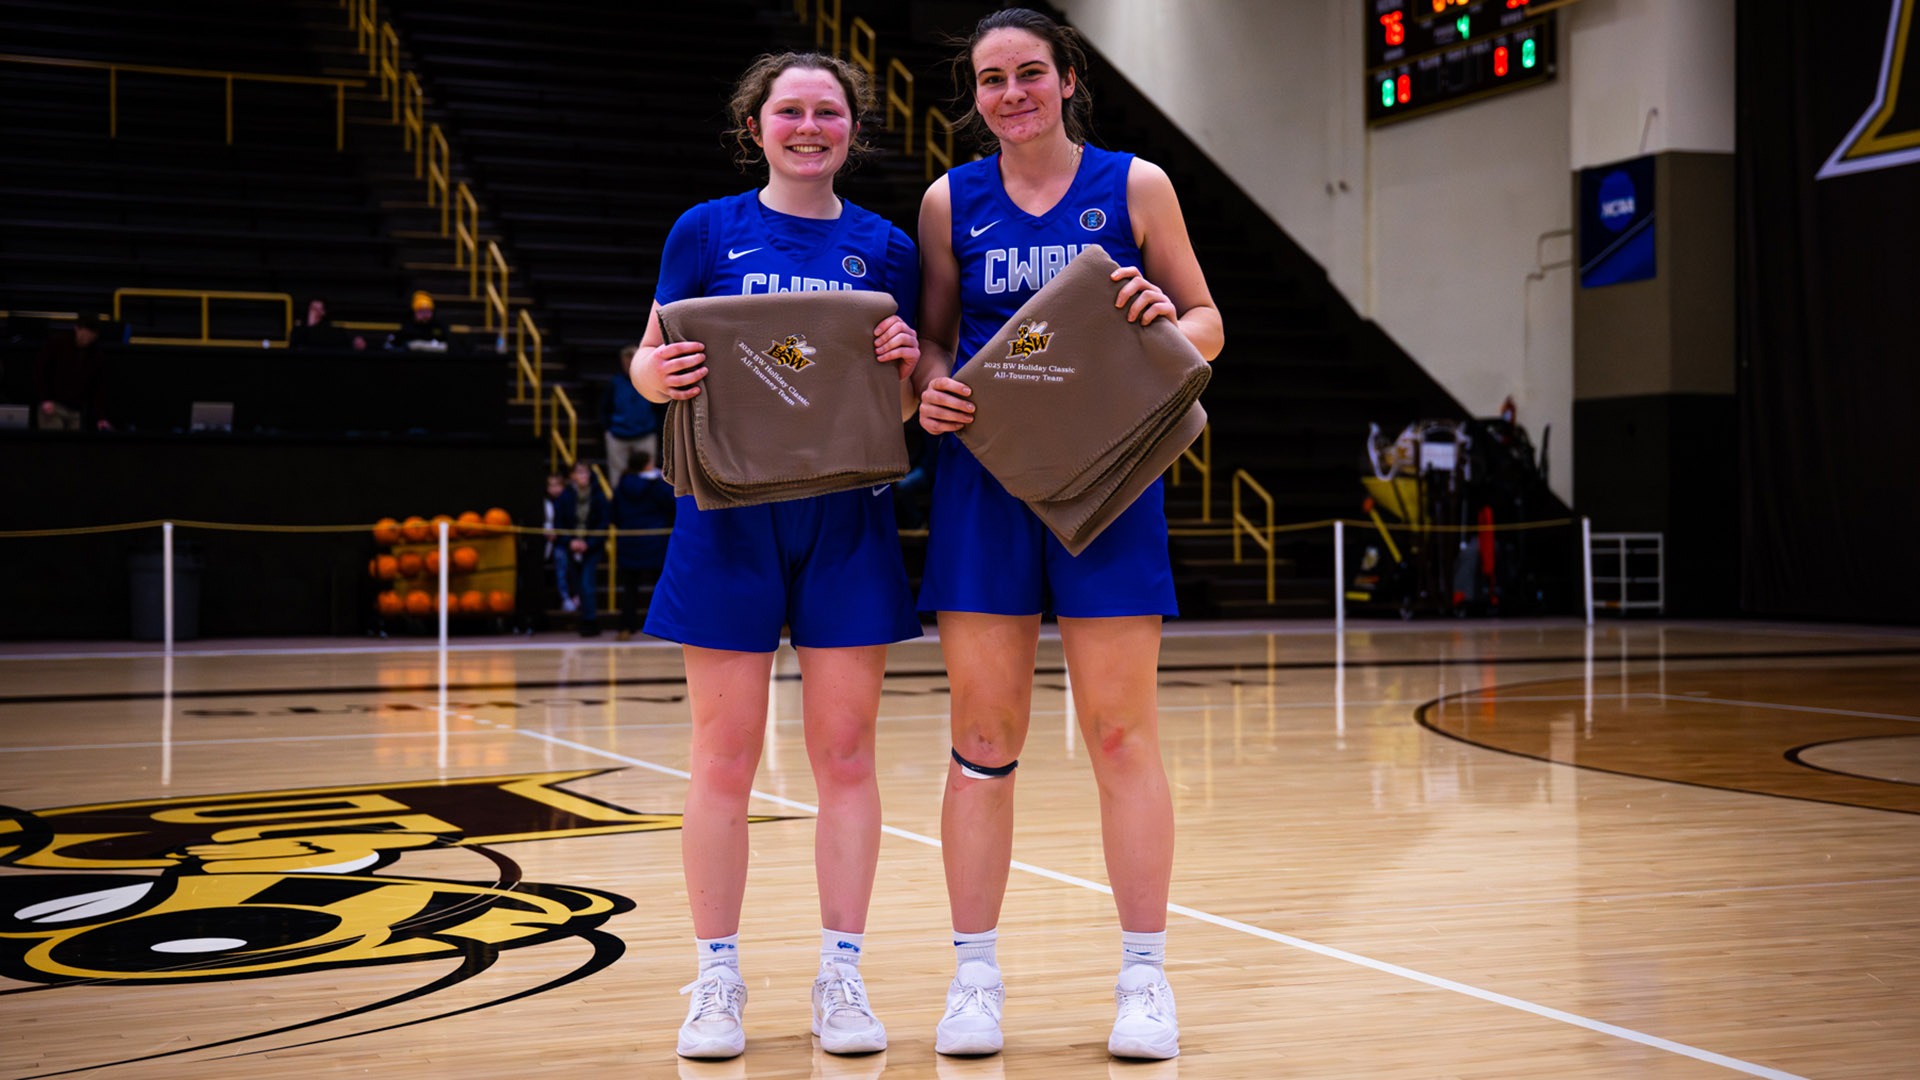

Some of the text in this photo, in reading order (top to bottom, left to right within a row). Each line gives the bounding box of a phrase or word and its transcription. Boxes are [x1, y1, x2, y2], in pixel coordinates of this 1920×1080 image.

[985, 243, 1094, 294] CWR
[741, 356, 795, 406] All-Tourney Team
[753, 354, 767, 366] BW
[764, 365, 789, 388] Holiday
[788, 386, 810, 407] Classic
[994, 371, 1064, 382] All-Tourney Team
[1018, 363, 1047, 373] Holiday
[1048, 365, 1076, 373] Classic
